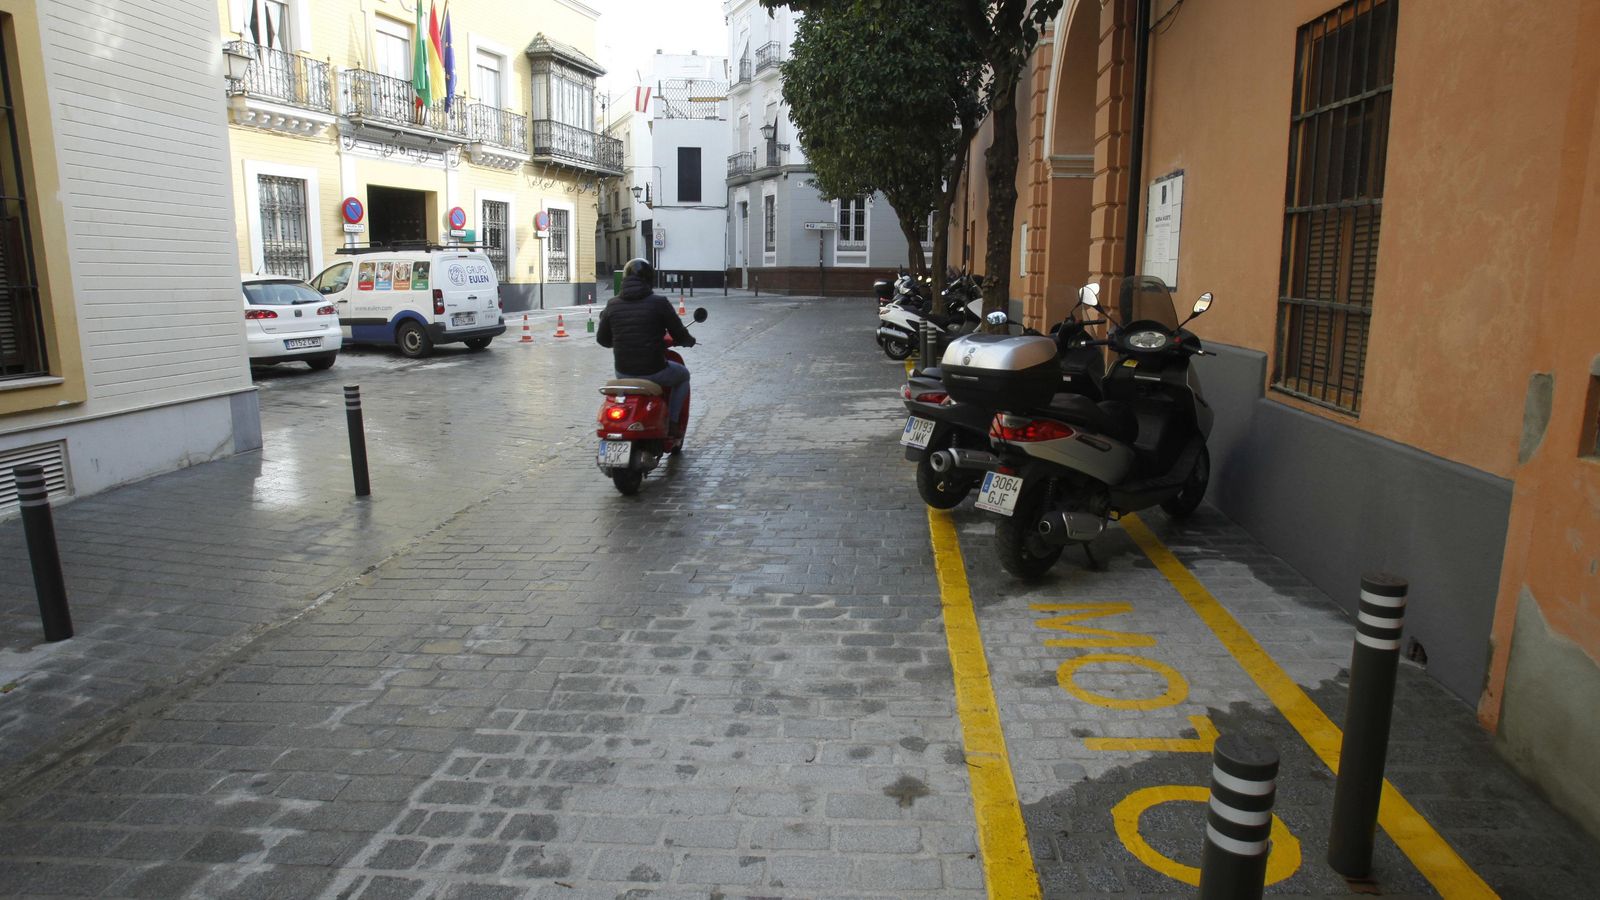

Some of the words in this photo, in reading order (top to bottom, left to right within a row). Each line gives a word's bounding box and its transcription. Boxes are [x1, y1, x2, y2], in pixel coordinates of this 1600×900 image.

[466, 266, 487, 274] GRUPO
[469, 275, 489, 283] EULEN
[913, 419, 934, 434] 0193
[910, 431, 927, 444] JMK
[606, 442, 629, 453] 6022
[992, 475, 1019, 493] 3064
[987, 490, 1009, 506] GJF
[1029, 601, 1303, 888] MOTO
